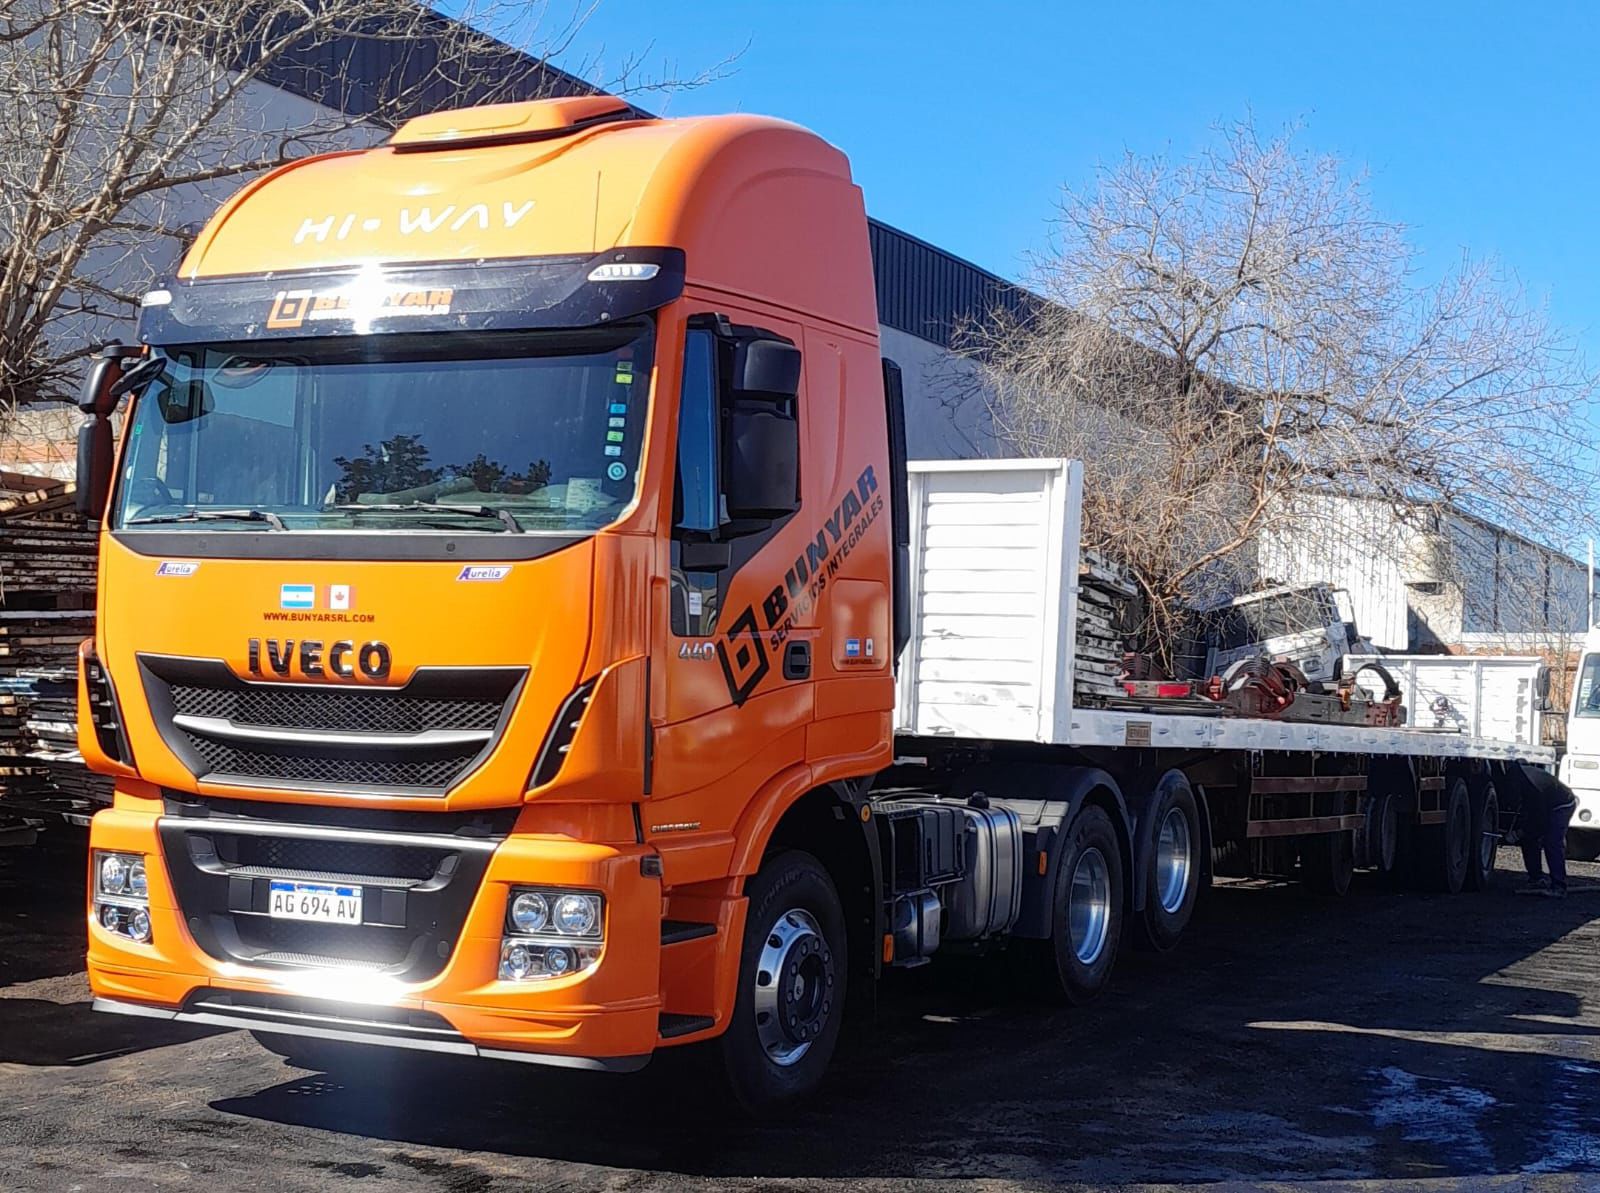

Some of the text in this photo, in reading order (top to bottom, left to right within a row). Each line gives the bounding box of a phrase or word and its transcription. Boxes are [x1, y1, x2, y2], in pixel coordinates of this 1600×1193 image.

[762, 465, 878, 629] BUNYAR
[827, 495, 883, 579] INTEGRALES
[157, 562, 192, 574] Aurelia
[459, 567, 501, 579] Aurelia
[263, 612, 375, 623] WWW.BUNYARSRL.COM
[247, 638, 391, 678] IVECO
[678, 641, 715, 660] 440
[274, 894, 357, 919] AG 694 AV
